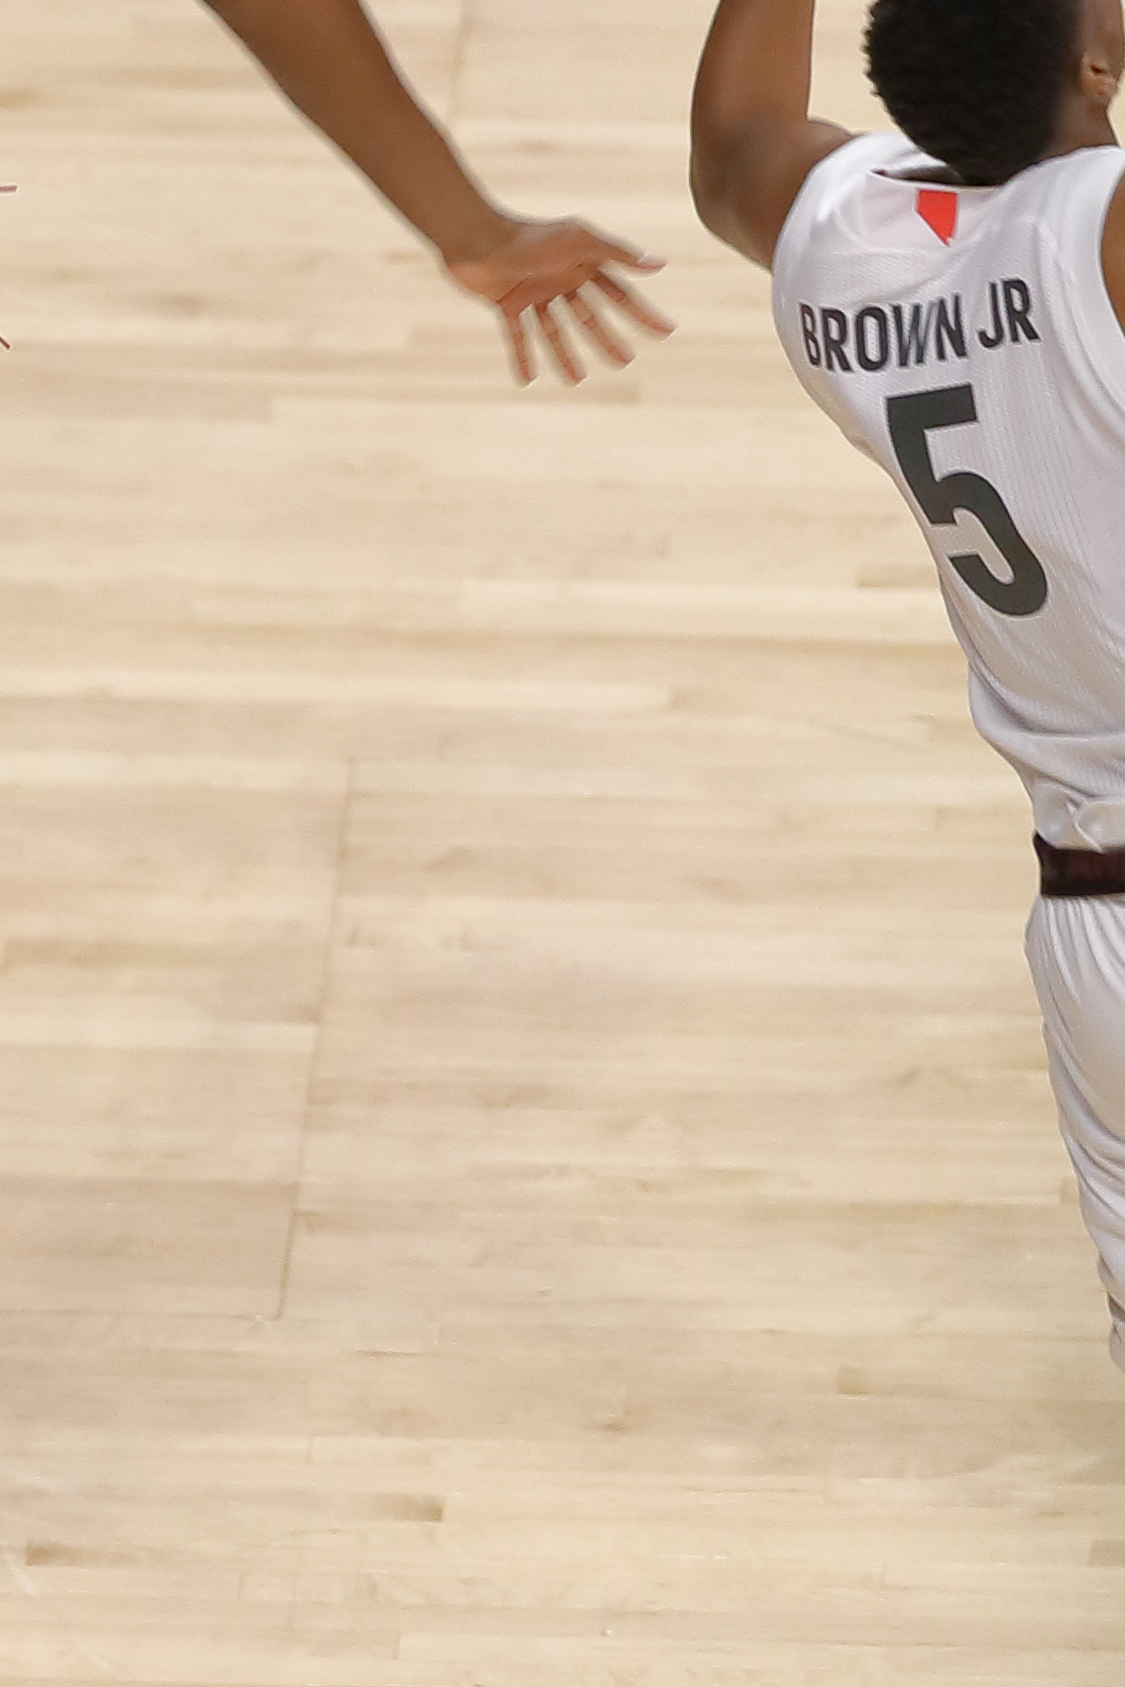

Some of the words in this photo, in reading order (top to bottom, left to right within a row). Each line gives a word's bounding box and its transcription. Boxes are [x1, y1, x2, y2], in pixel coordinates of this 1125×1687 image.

[798, 292, 969, 373] BROWN
[976, 277, 1041, 350] JR
[885, 381, 1049, 617] 5
